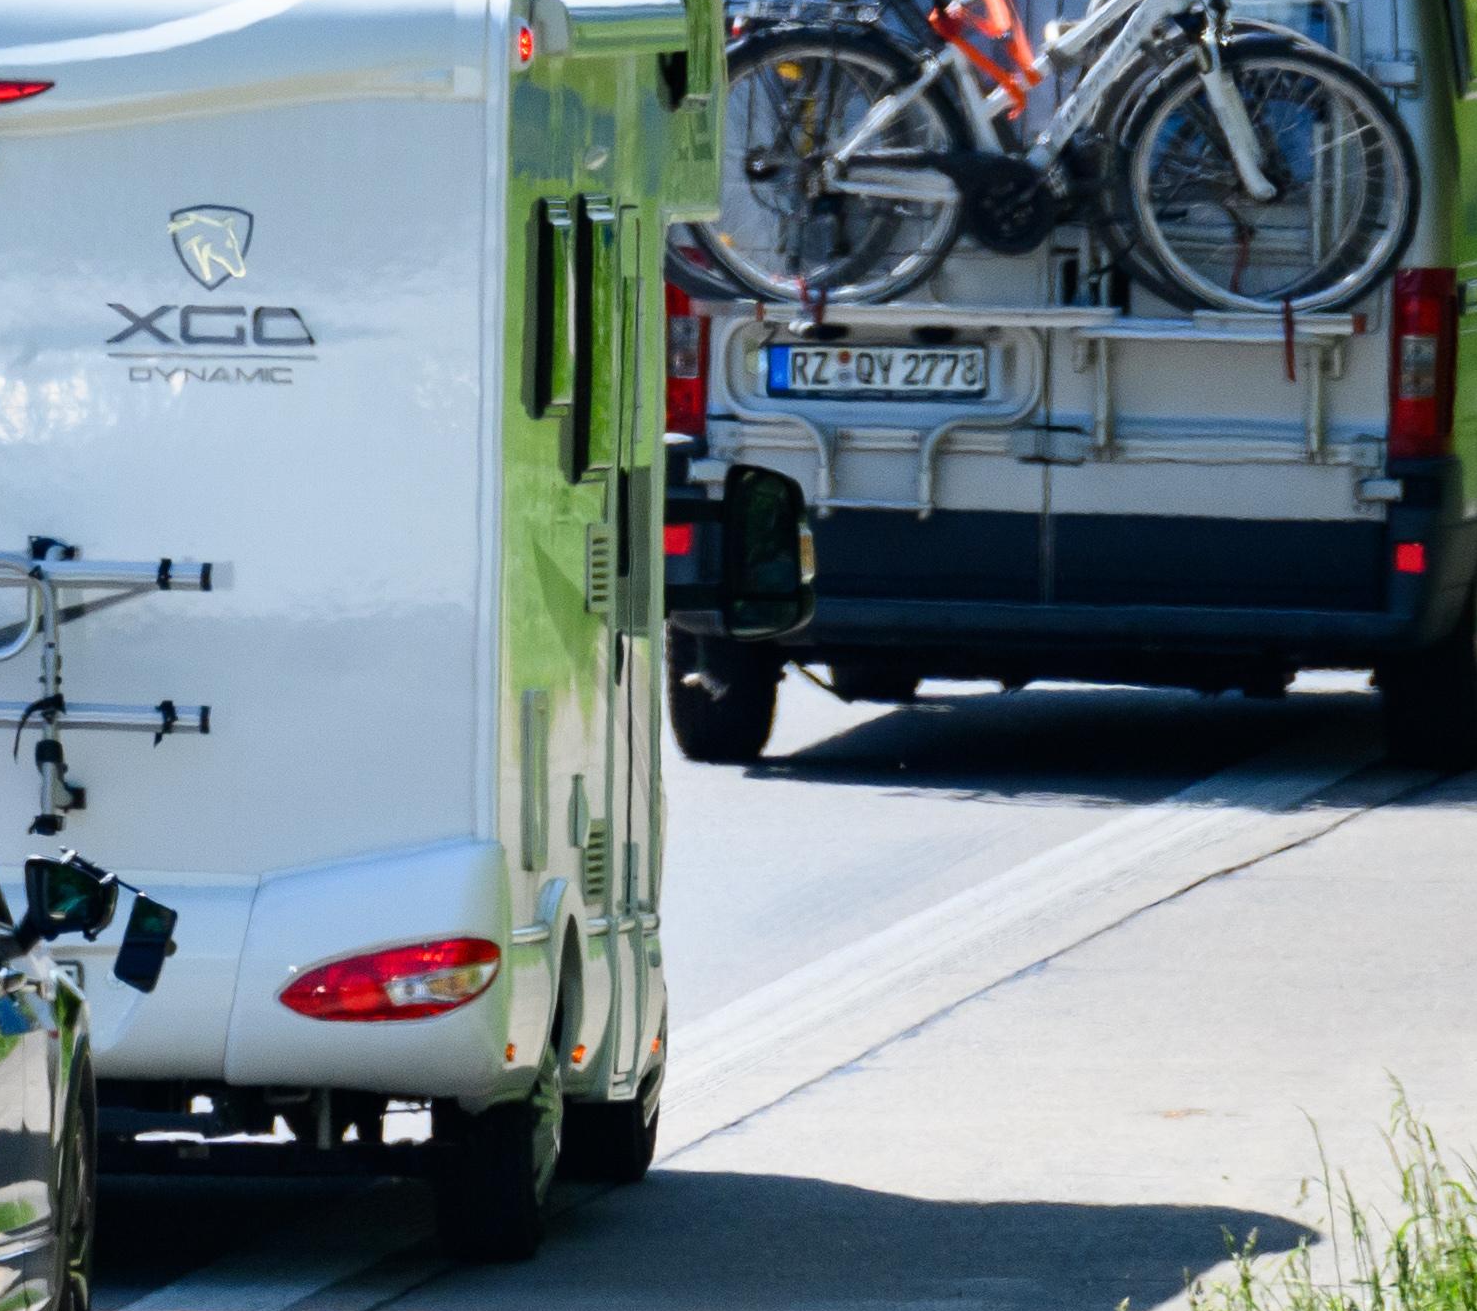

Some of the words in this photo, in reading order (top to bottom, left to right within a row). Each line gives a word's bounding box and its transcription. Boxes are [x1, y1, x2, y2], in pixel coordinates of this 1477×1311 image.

[129, 366, 294, 385] DYNAMIC
[792, 351, 829, 386] RZ
[856, 351, 893, 387] QY
